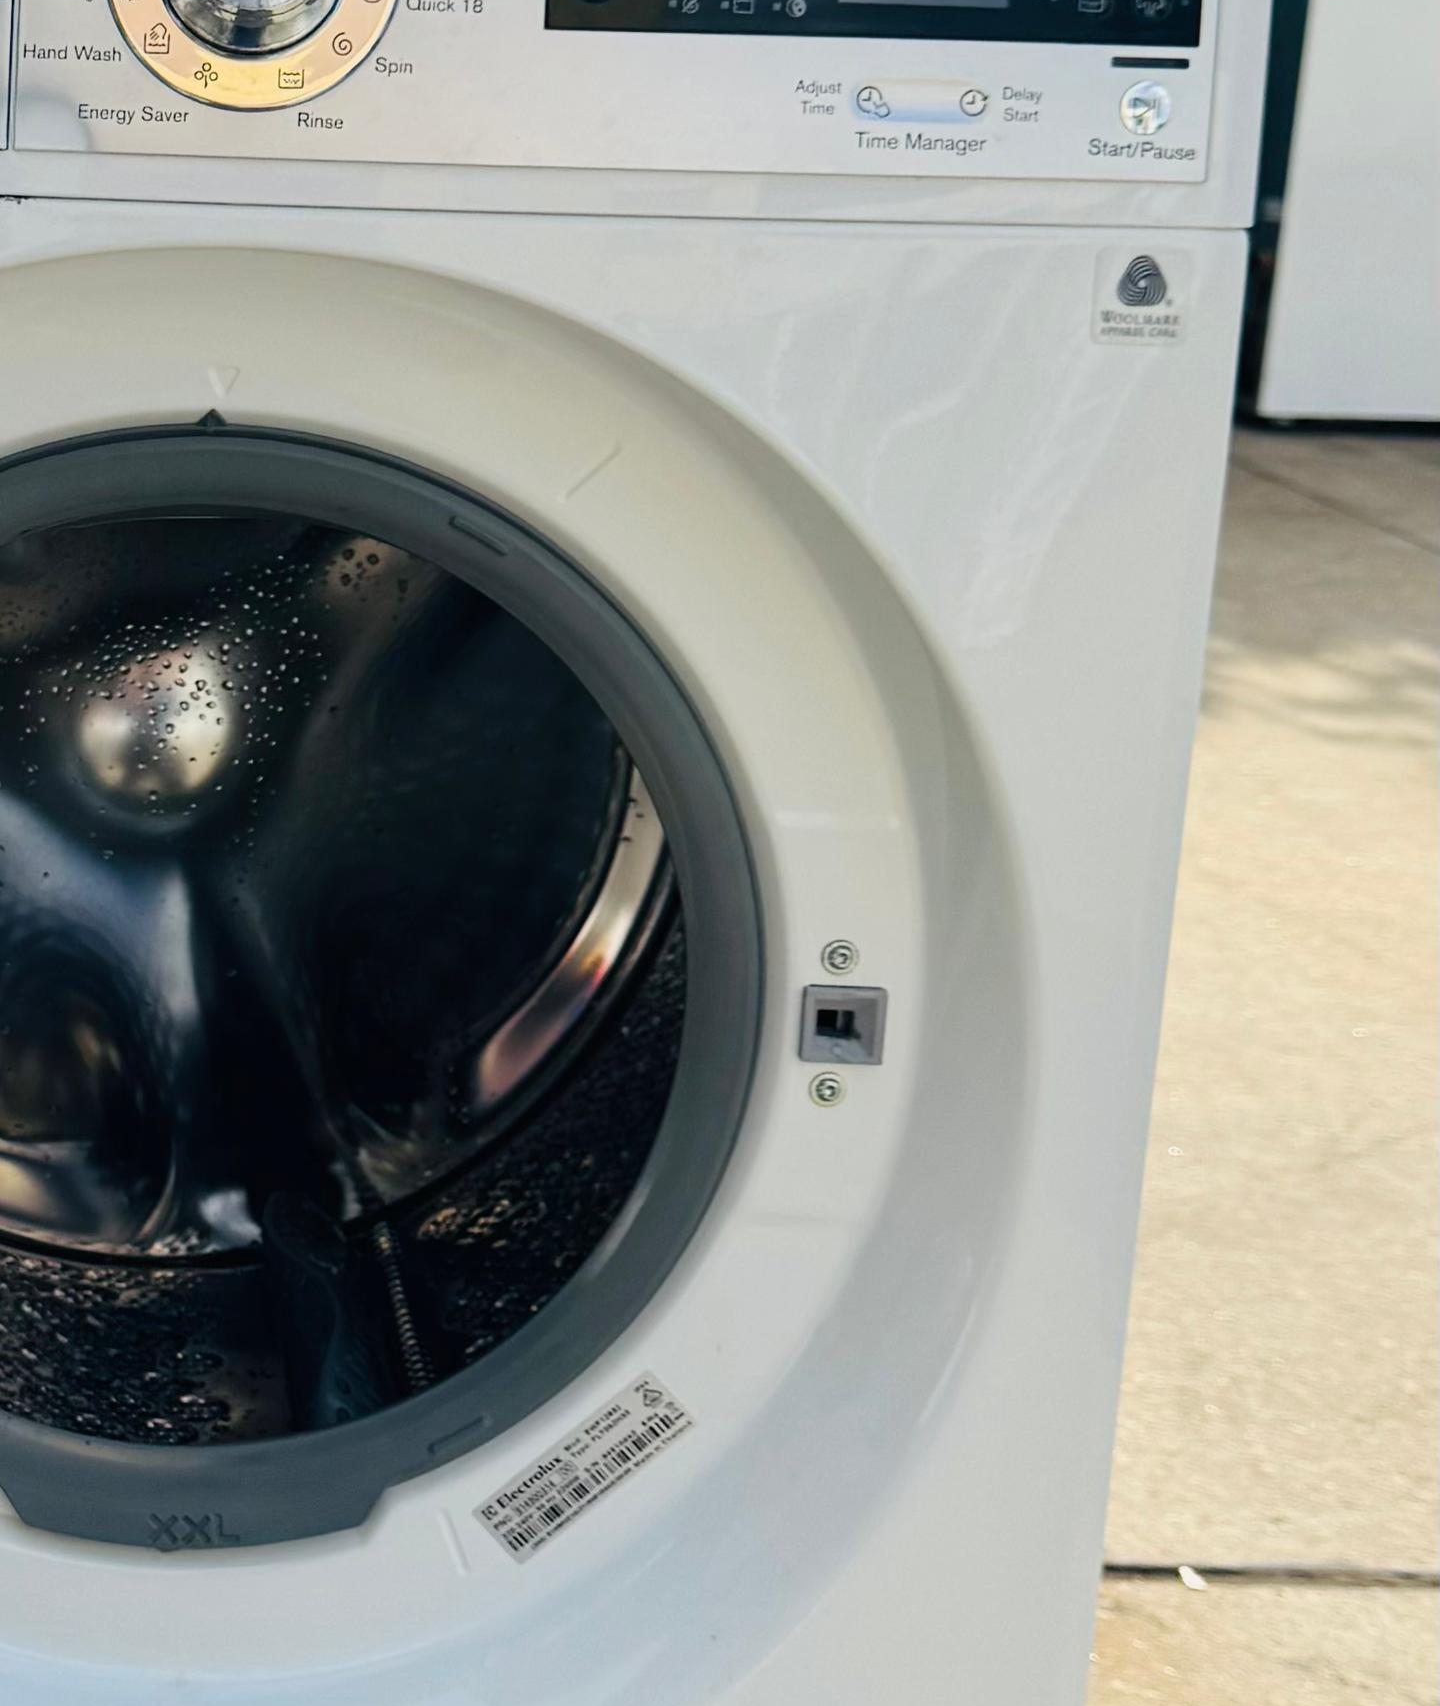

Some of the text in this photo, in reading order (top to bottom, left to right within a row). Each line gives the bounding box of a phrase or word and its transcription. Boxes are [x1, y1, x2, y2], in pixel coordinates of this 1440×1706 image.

[23, 44, 122, 62] Hand Wash
[375, 58, 414, 77] Spin
[795, 79, 842, 97] Adjust
[1002, 87, 1043, 105] Delay
[77, 104, 190, 125] Energy Saver
[800, 101, 835, 115] Time
[1003, 108, 1039, 123] Start
[297, 112, 344, 130] Rinse
[854, 131, 988, 156] Time Manager
[1088, 139, 1197, 162] Start/Pause
[496, 1457, 563, 1509] Electrolux
[146, 1512, 240, 1545] XXL
